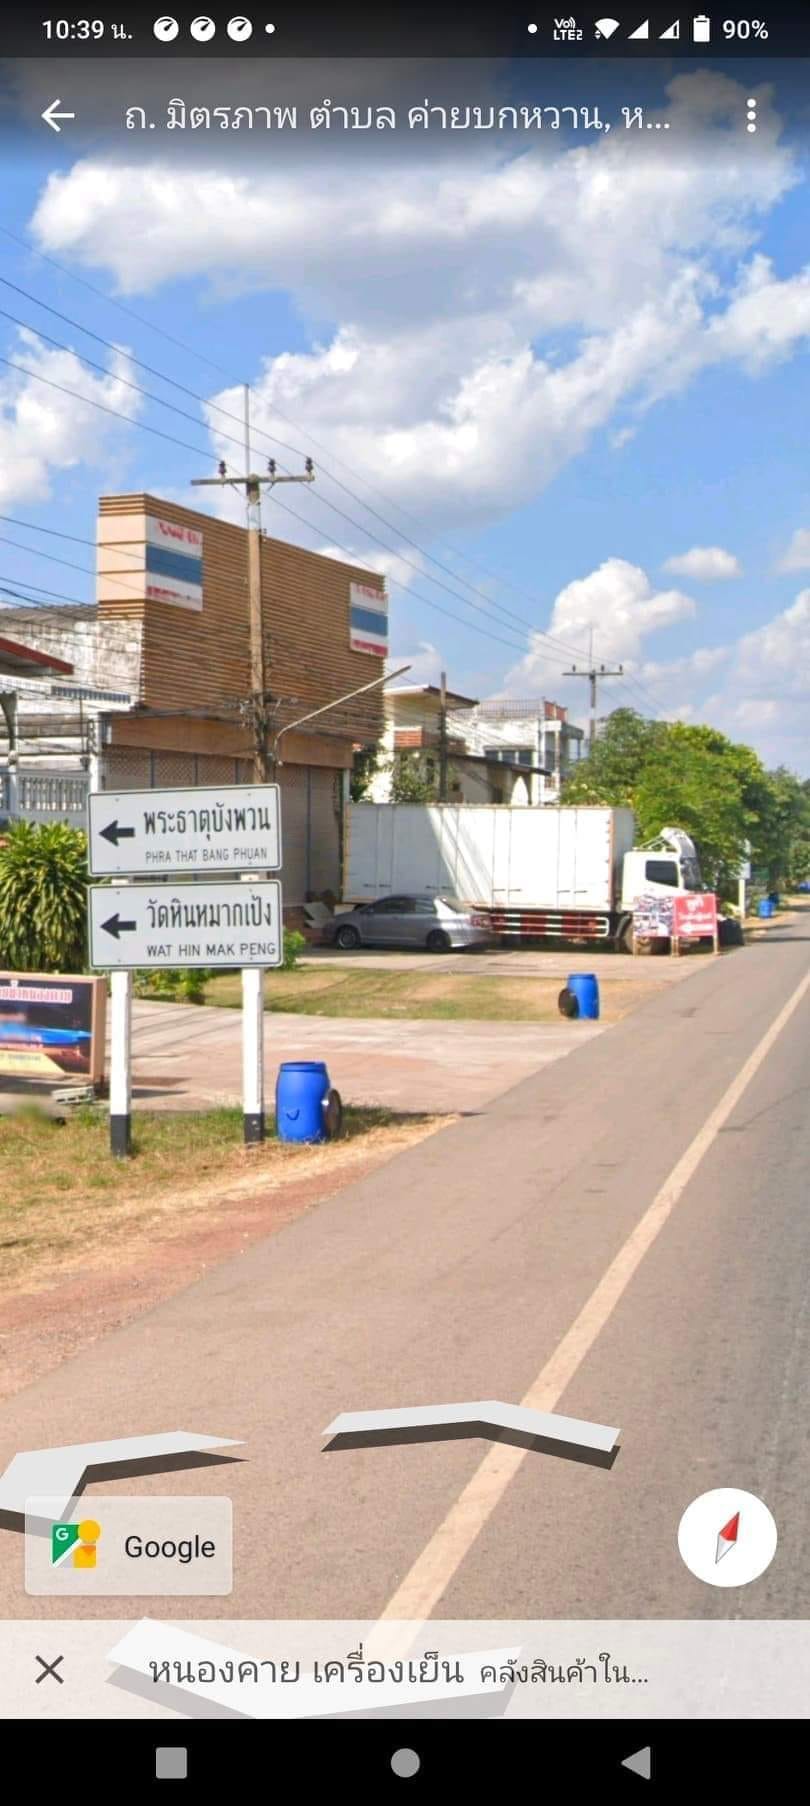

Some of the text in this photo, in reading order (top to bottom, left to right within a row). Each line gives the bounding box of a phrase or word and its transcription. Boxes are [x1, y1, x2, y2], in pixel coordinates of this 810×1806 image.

[144, 802, 271, 841] พระธาตุบังพวน
[145, 847, 267, 864] PHRA THAT BANG PHUAN
[147, 894, 272, 929] วัดหินหมากเป้ง
[147, 942, 276, 957] WAT HIN MAK PENG
